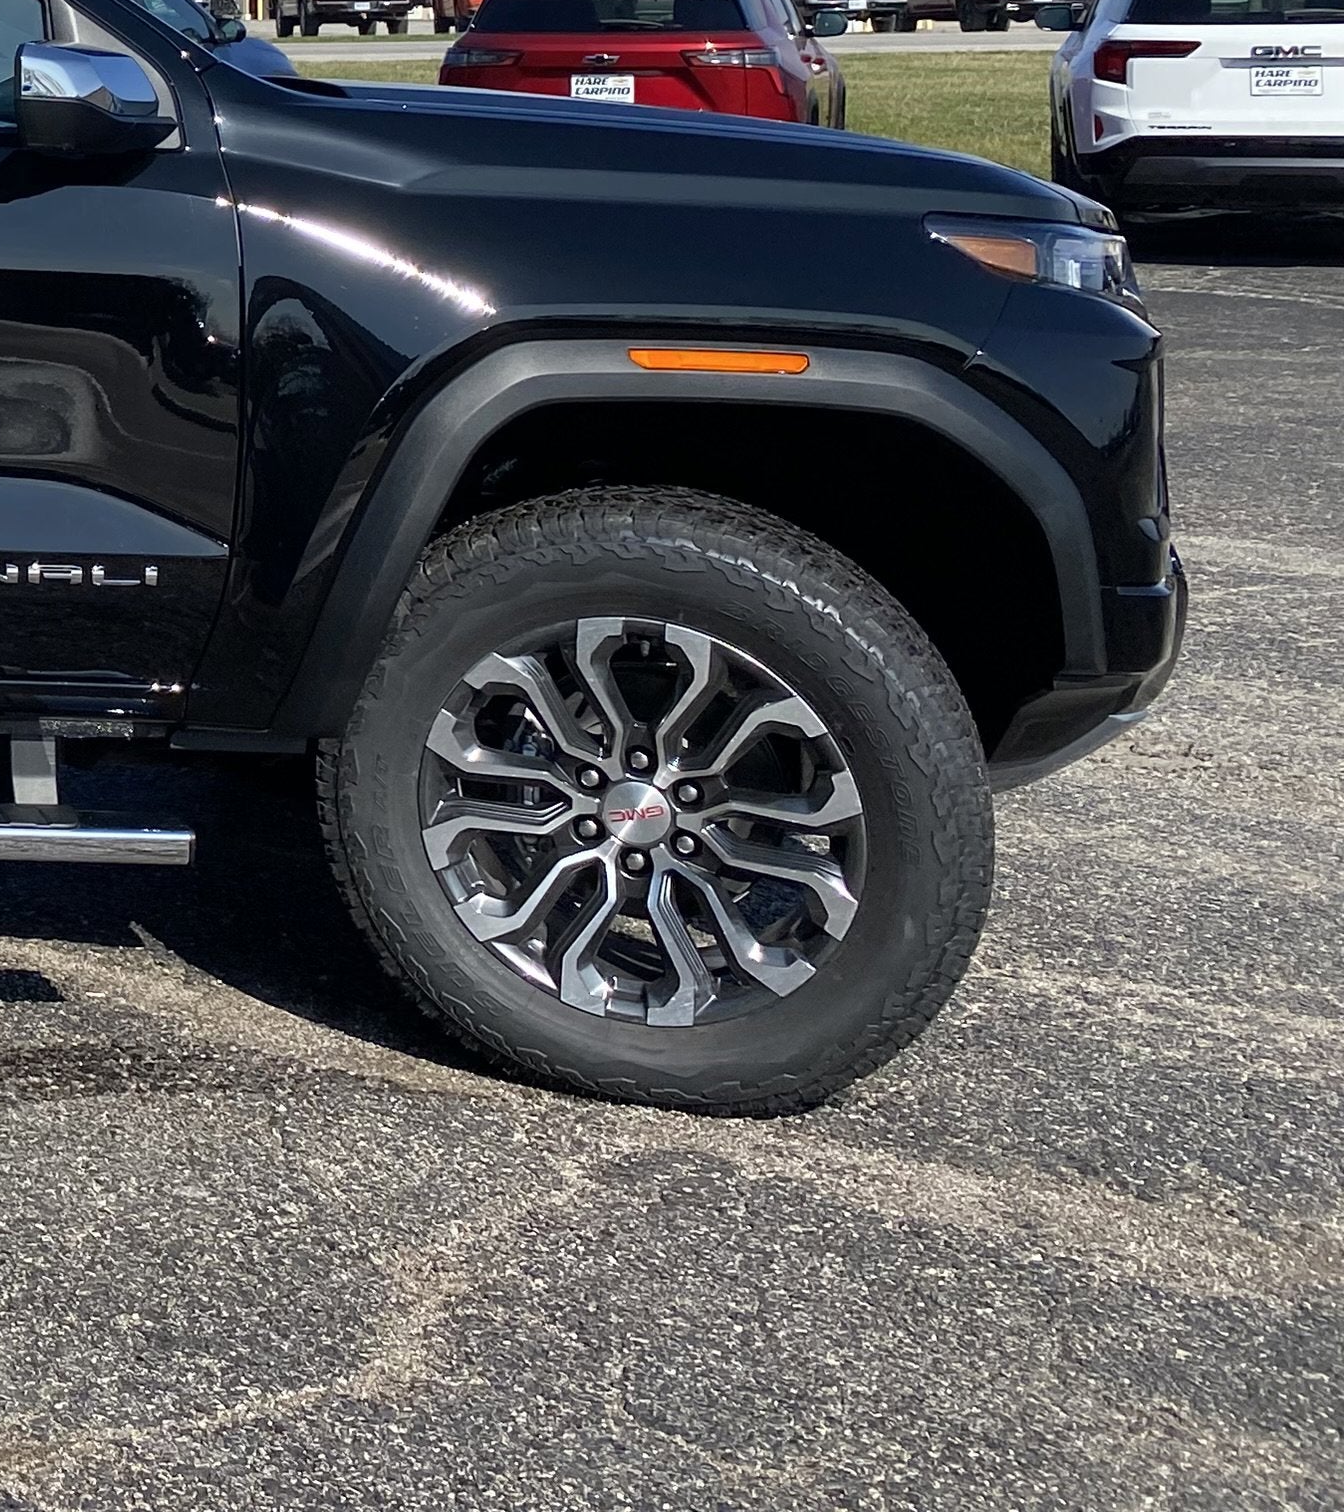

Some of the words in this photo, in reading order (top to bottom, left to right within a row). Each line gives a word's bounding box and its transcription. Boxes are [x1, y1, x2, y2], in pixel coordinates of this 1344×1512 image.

[1251, 46, 1322, 57] GMC
[1254, 70, 1294, 78] HARE
[574, 77, 609, 86] HARE
[1255, 79, 1319, 88] CARPINO
[574, 87, 631, 96] CARPINO
[717, 598, 923, 869] BRIDGESTONE
[608, 803, 665, 823] GMC
[372, 823, 515, 1019] DUELER
